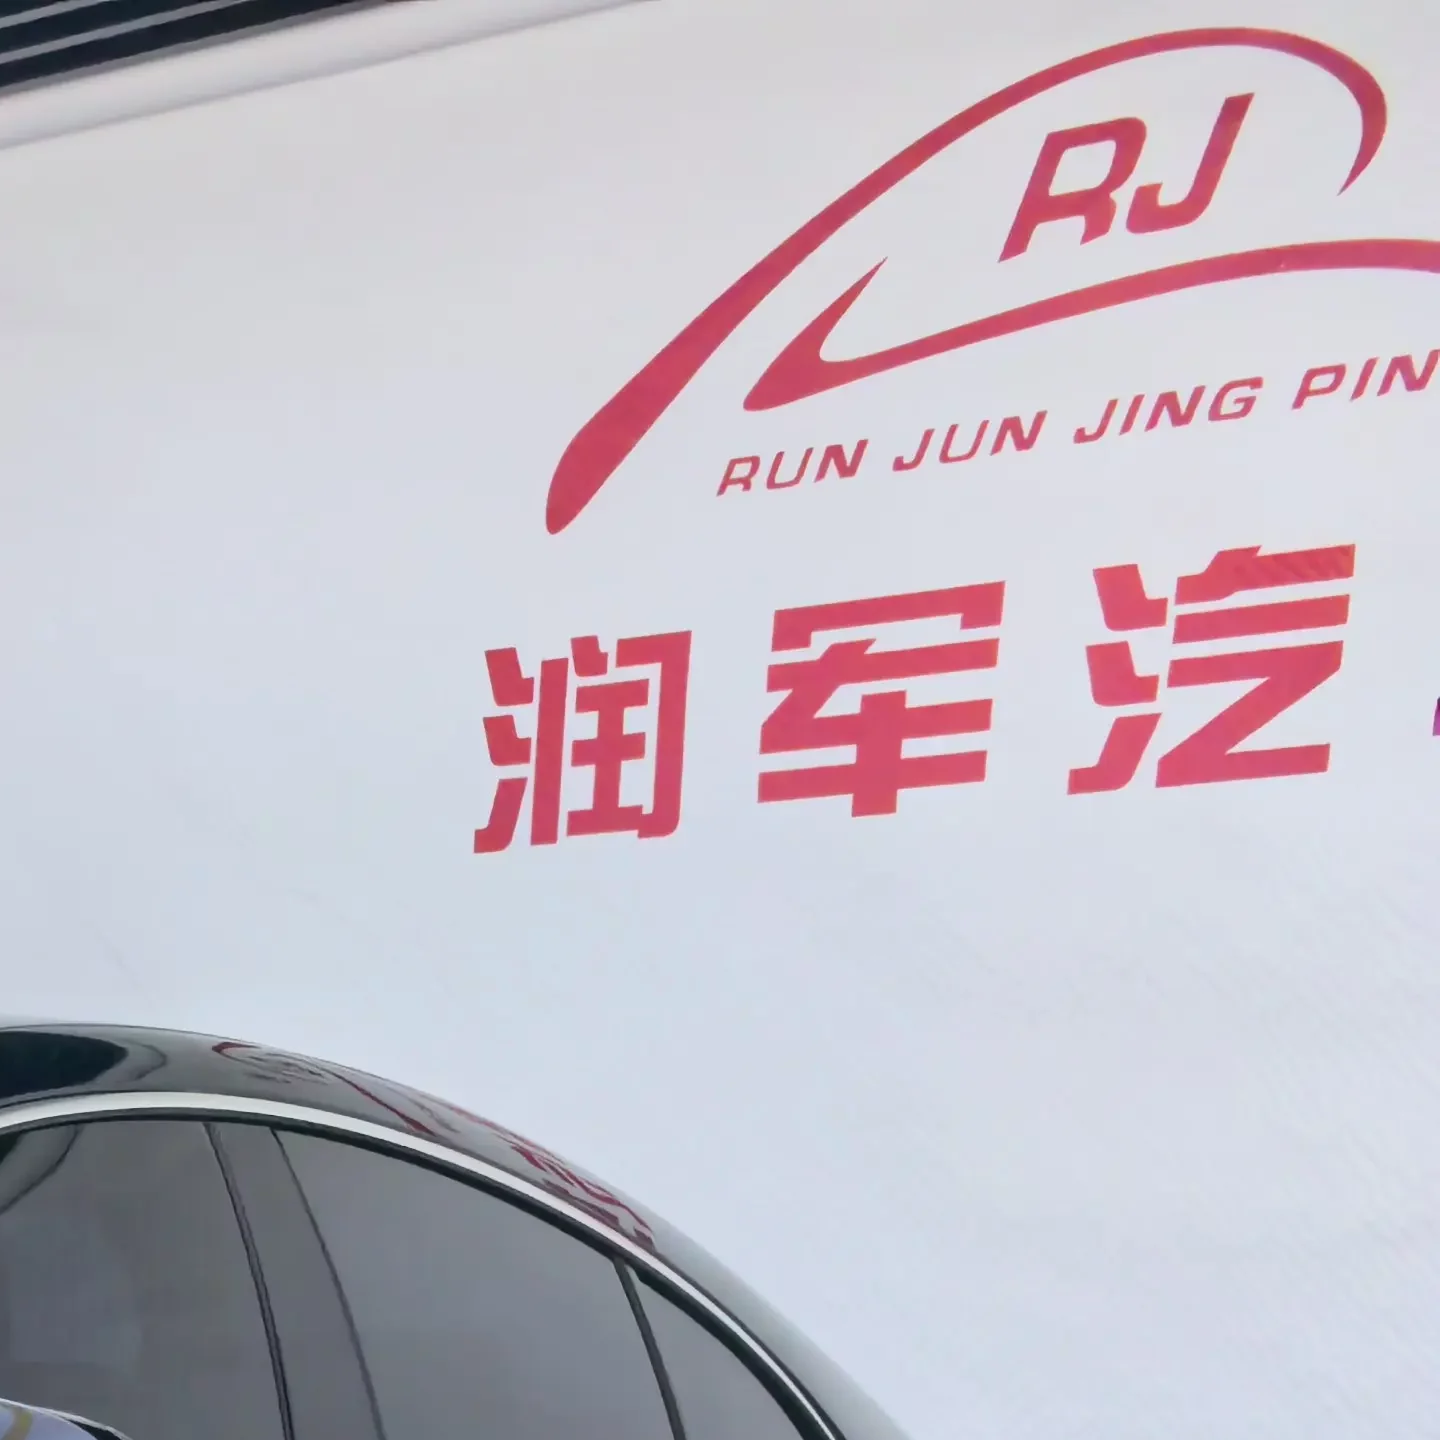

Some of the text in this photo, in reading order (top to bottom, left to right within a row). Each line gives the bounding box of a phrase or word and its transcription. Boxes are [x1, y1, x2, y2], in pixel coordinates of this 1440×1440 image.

[997, 92, 1255, 264] RJ
[716, 349, 1440, 497] RUN JUN JING PIN
[473, 543, 1440, 853] 润军汽
